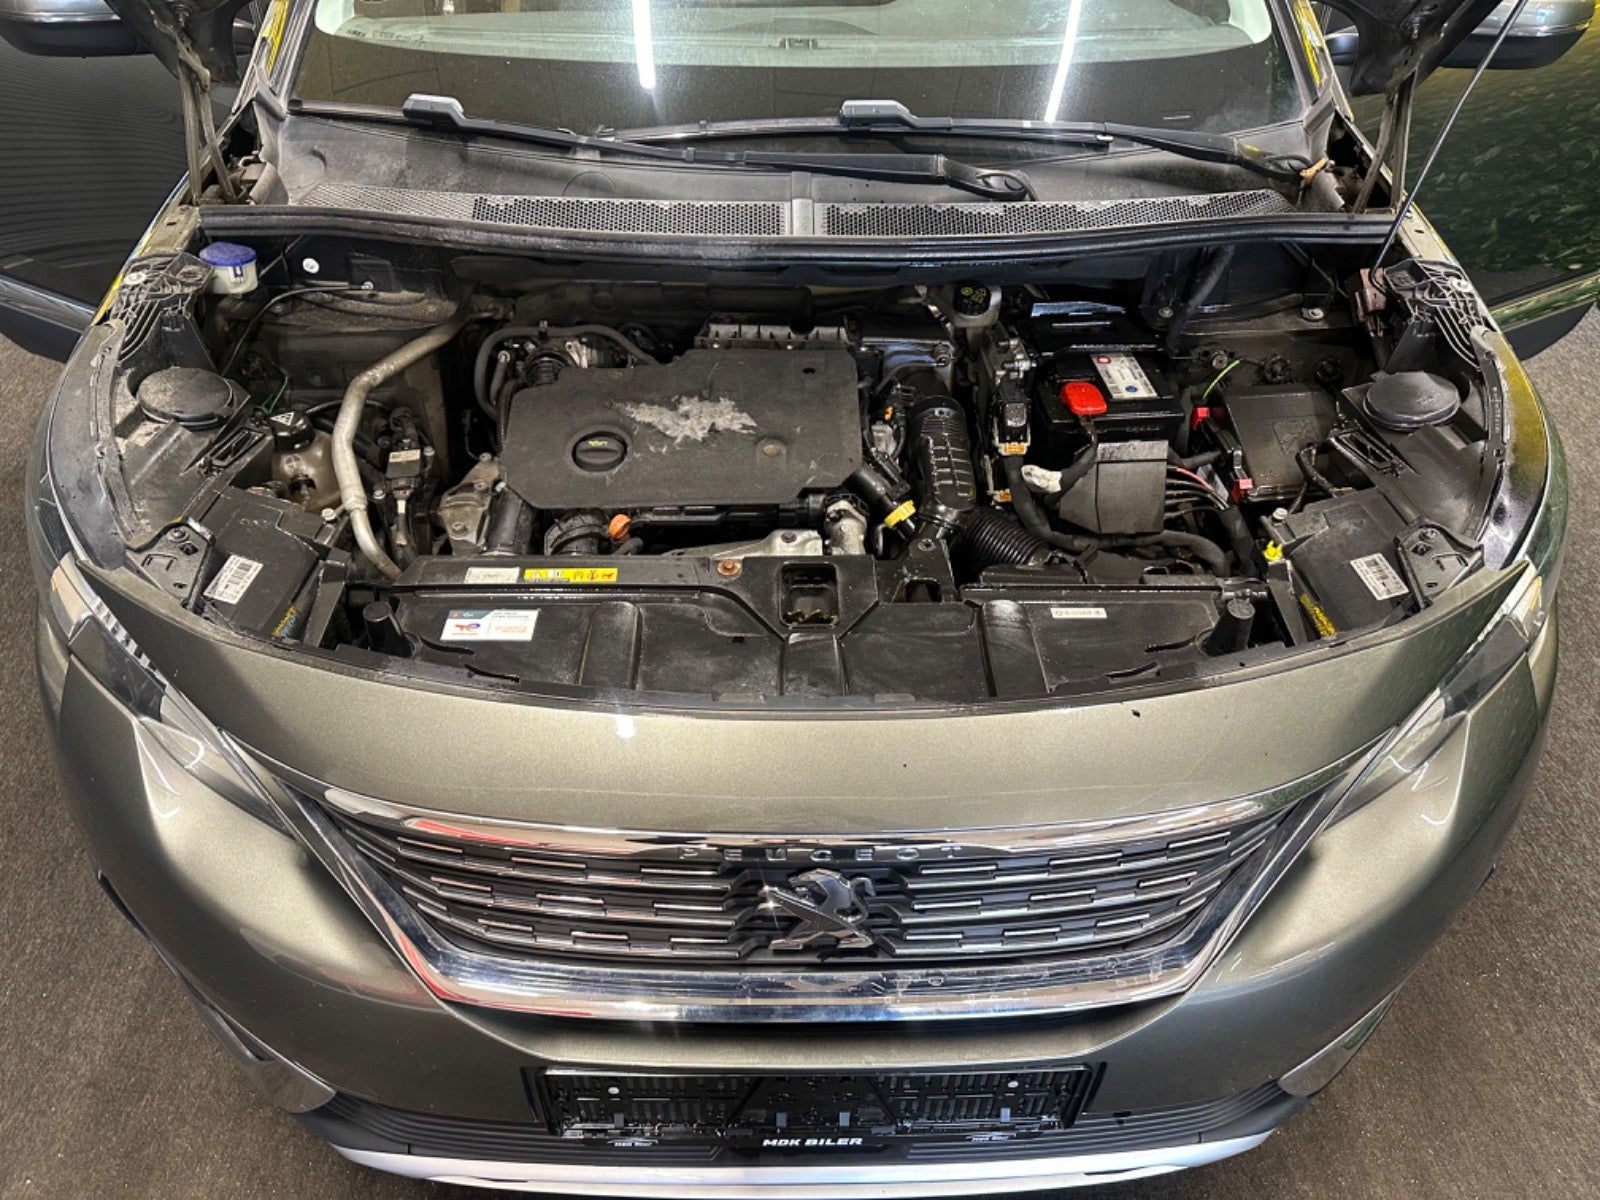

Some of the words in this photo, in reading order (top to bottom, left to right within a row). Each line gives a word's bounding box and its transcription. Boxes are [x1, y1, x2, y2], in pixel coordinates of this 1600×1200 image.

[678, 845, 962, 861] PEUGEOT
[762, 1138, 802, 1147] MDK
[804, 1137, 863, 1146] BILER
